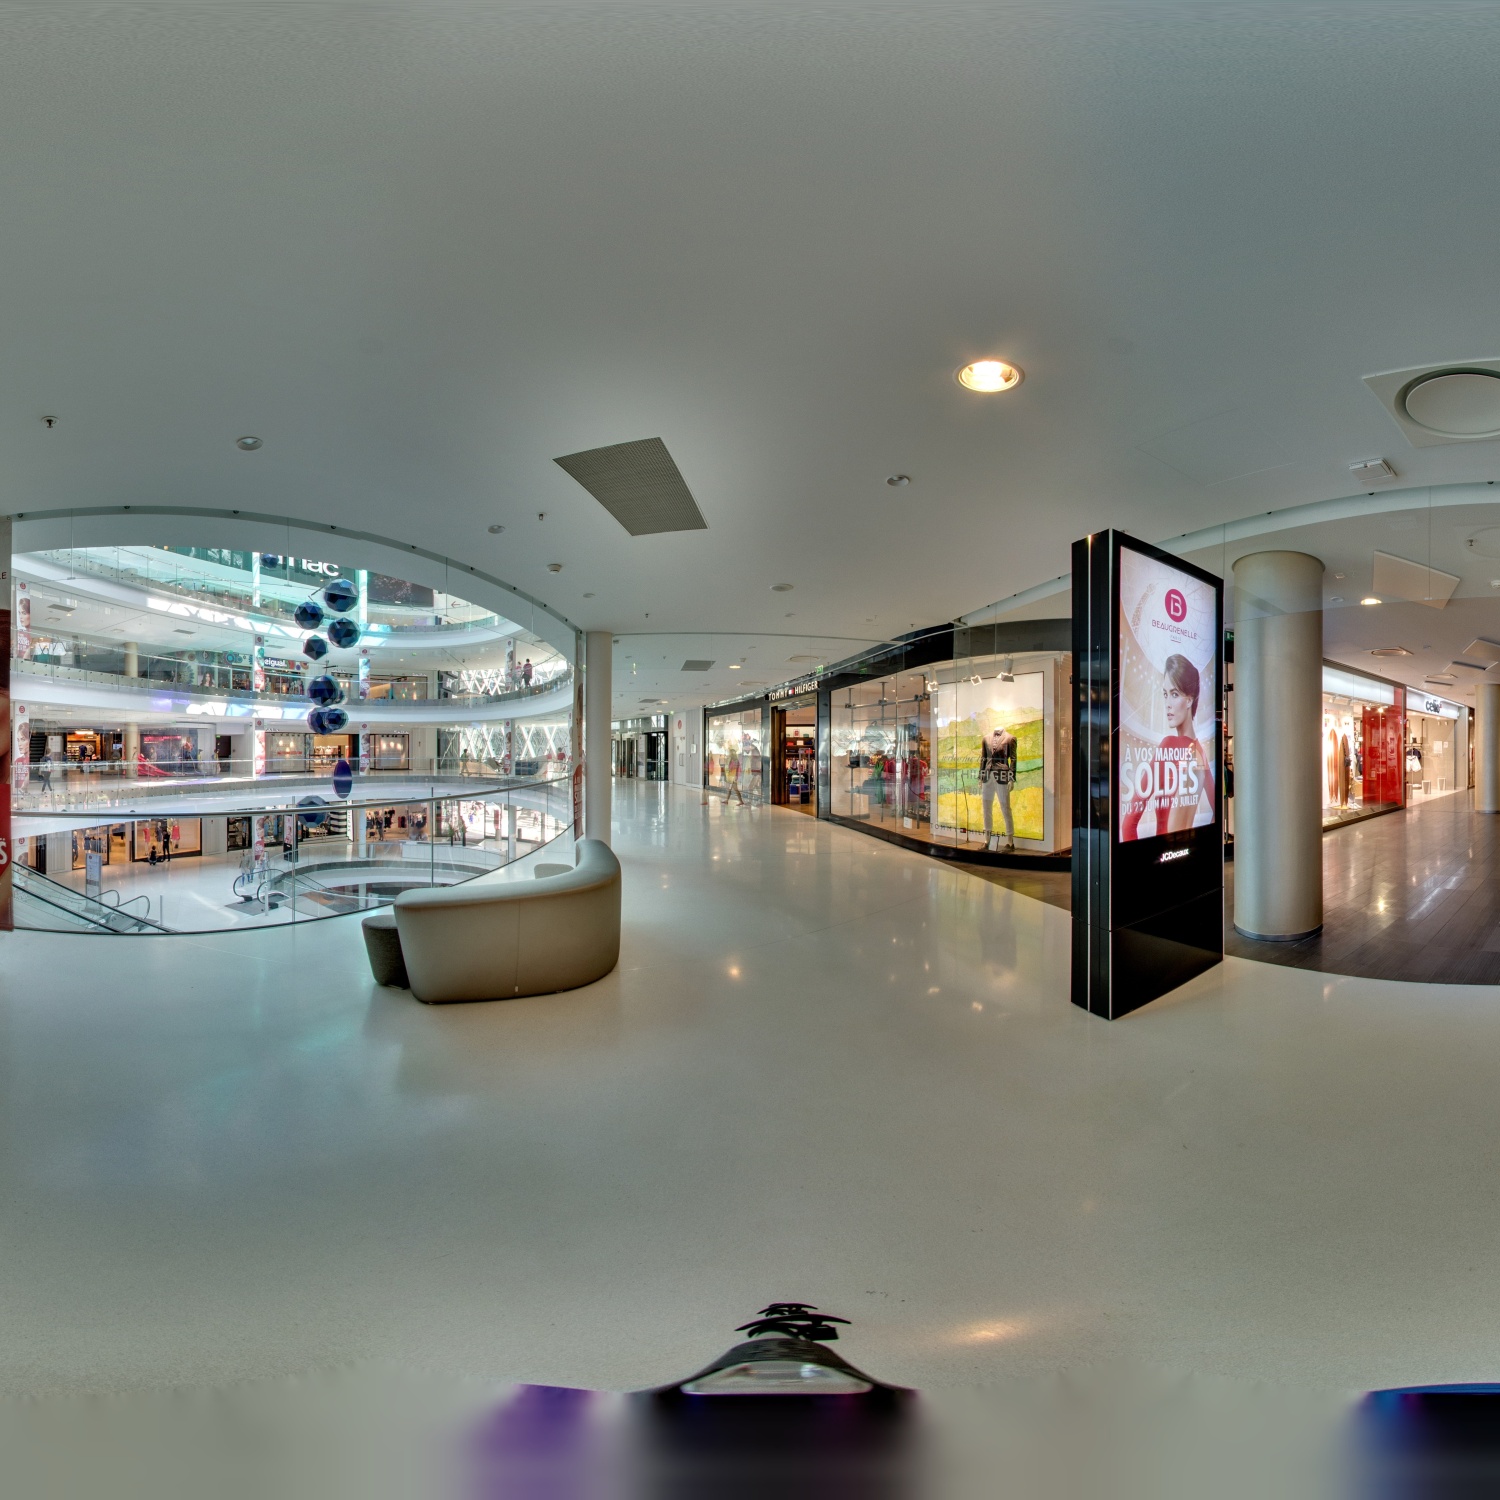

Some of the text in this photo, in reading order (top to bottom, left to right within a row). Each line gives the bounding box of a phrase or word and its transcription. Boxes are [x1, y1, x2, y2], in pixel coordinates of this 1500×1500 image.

[1151, 619, 1198, 640] BEAUGRENELLE
[768, 680, 818, 701] TOMMY HILFIGER
[1125, 743, 1131, 762] À
[1134, 747, 1153, 761] VOS
[961, 769, 1015, 782] HILFIGER
[1120, 760, 1199, 802] SOLDES
[1121, 802, 1132, 816] DU
[1145, 799, 1159, 812] JUIN
[1160, 798, 1170, 809] AU
[1170, 797, 1178, 809] 29
[1179, 794, 1199, 807] JUILLET
[930, 822, 957, 832] TOMMY
[1160, 848, 1189, 862] JCDecaux
